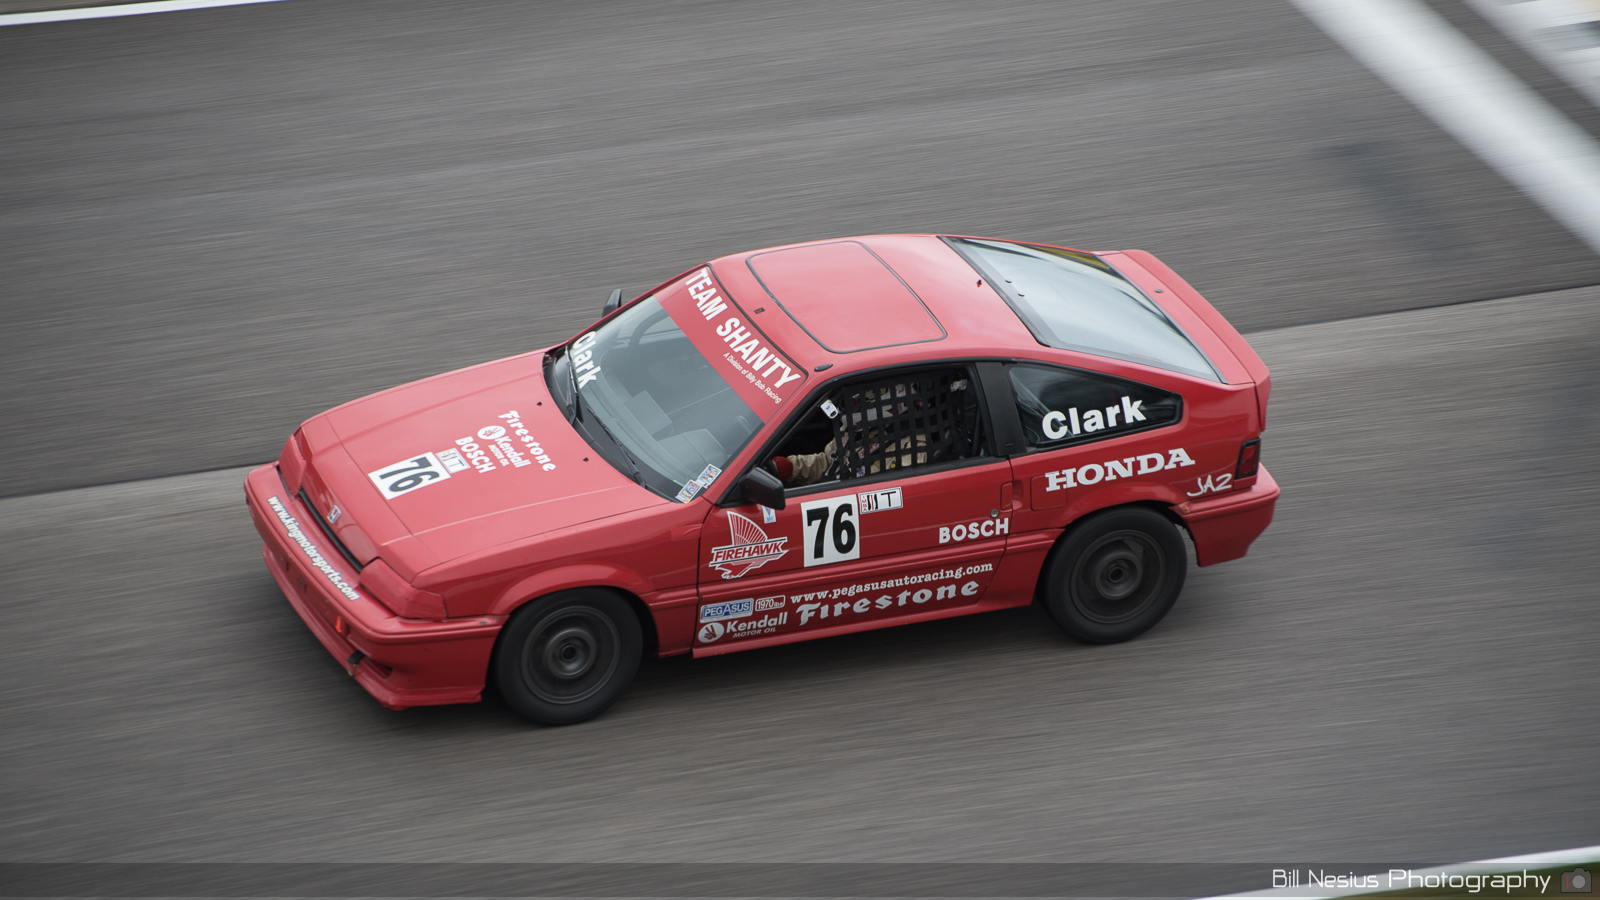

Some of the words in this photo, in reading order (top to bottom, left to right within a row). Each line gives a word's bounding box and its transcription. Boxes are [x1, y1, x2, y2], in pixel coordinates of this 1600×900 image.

[685, 268, 728, 321] TEAM
[716, 317, 801, 389] SHANTY
[572, 331, 601, 390] Clark
[727, 355, 743, 371] Division
[745, 372, 757, 384] Billy
[754, 380, 766, 390] Bob
[763, 387, 782, 404] Racing
[1042, 396, 1147, 440] Clark
[455, 436, 497, 473] BOSCH
[494, 436, 532, 468] Kendall
[497, 410, 557, 472] Firestone
[379, 456, 440, 493] 76
[1045, 447, 1196, 492] HONDA
[267, 495, 361, 601] www.kingmotorsports.com
[714, 541, 784, 562] FIREHAWK
[806, 503, 857, 560] 76
[939, 517, 1009, 544] BOSCH
[790, 563, 993, 604] www.pegasusautoracing.com
[796, 580, 979, 626] Firestone
[704, 602, 750, 618] PEGASUS
[726, 611, 788, 633] Kendall
[733, 629, 762, 638] MOTOR
[764, 626, 776, 634] OIL
